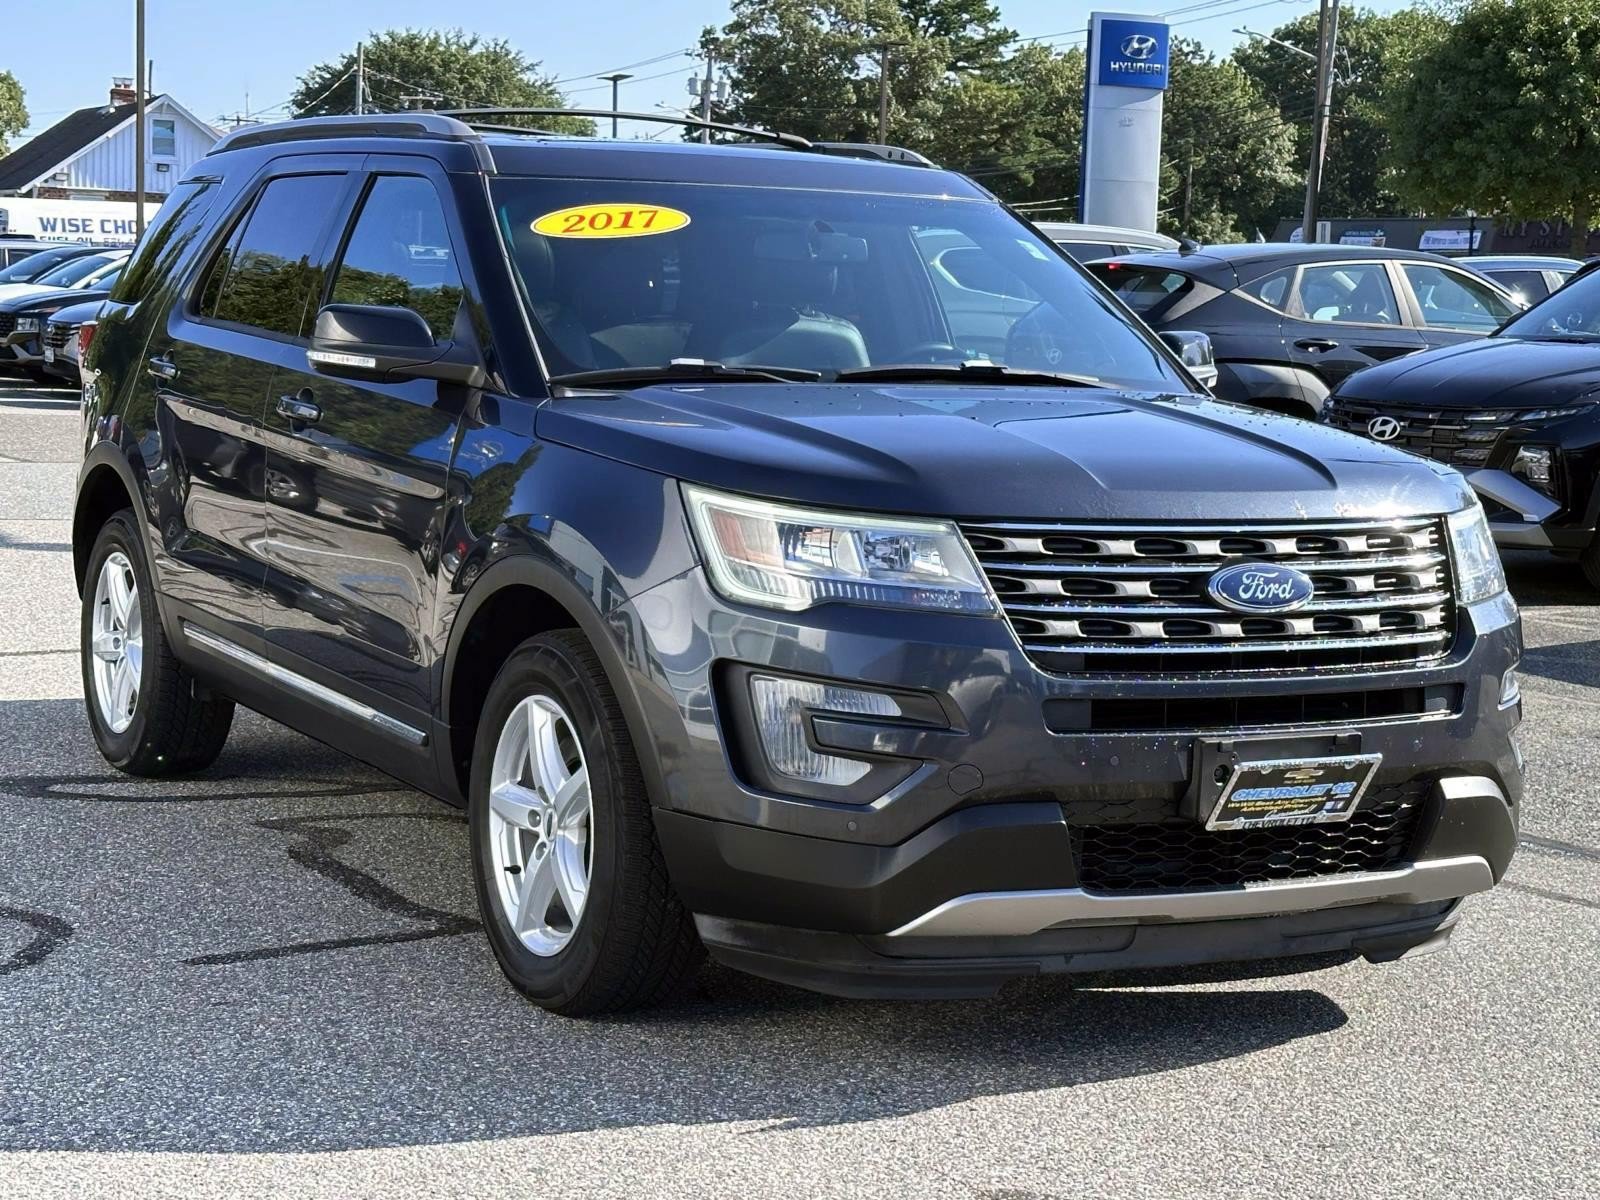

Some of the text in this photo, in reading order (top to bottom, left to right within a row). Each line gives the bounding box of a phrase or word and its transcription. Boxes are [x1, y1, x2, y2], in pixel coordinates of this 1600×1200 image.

[1110, 61, 1164, 75] HYUNDAI
[38, 217, 152, 234] WISE CHO
[562, 210, 659, 233] 2017
[1239, 571, 1294, 600] Ford
[1231, 784, 1333, 801] CHEVROLET
